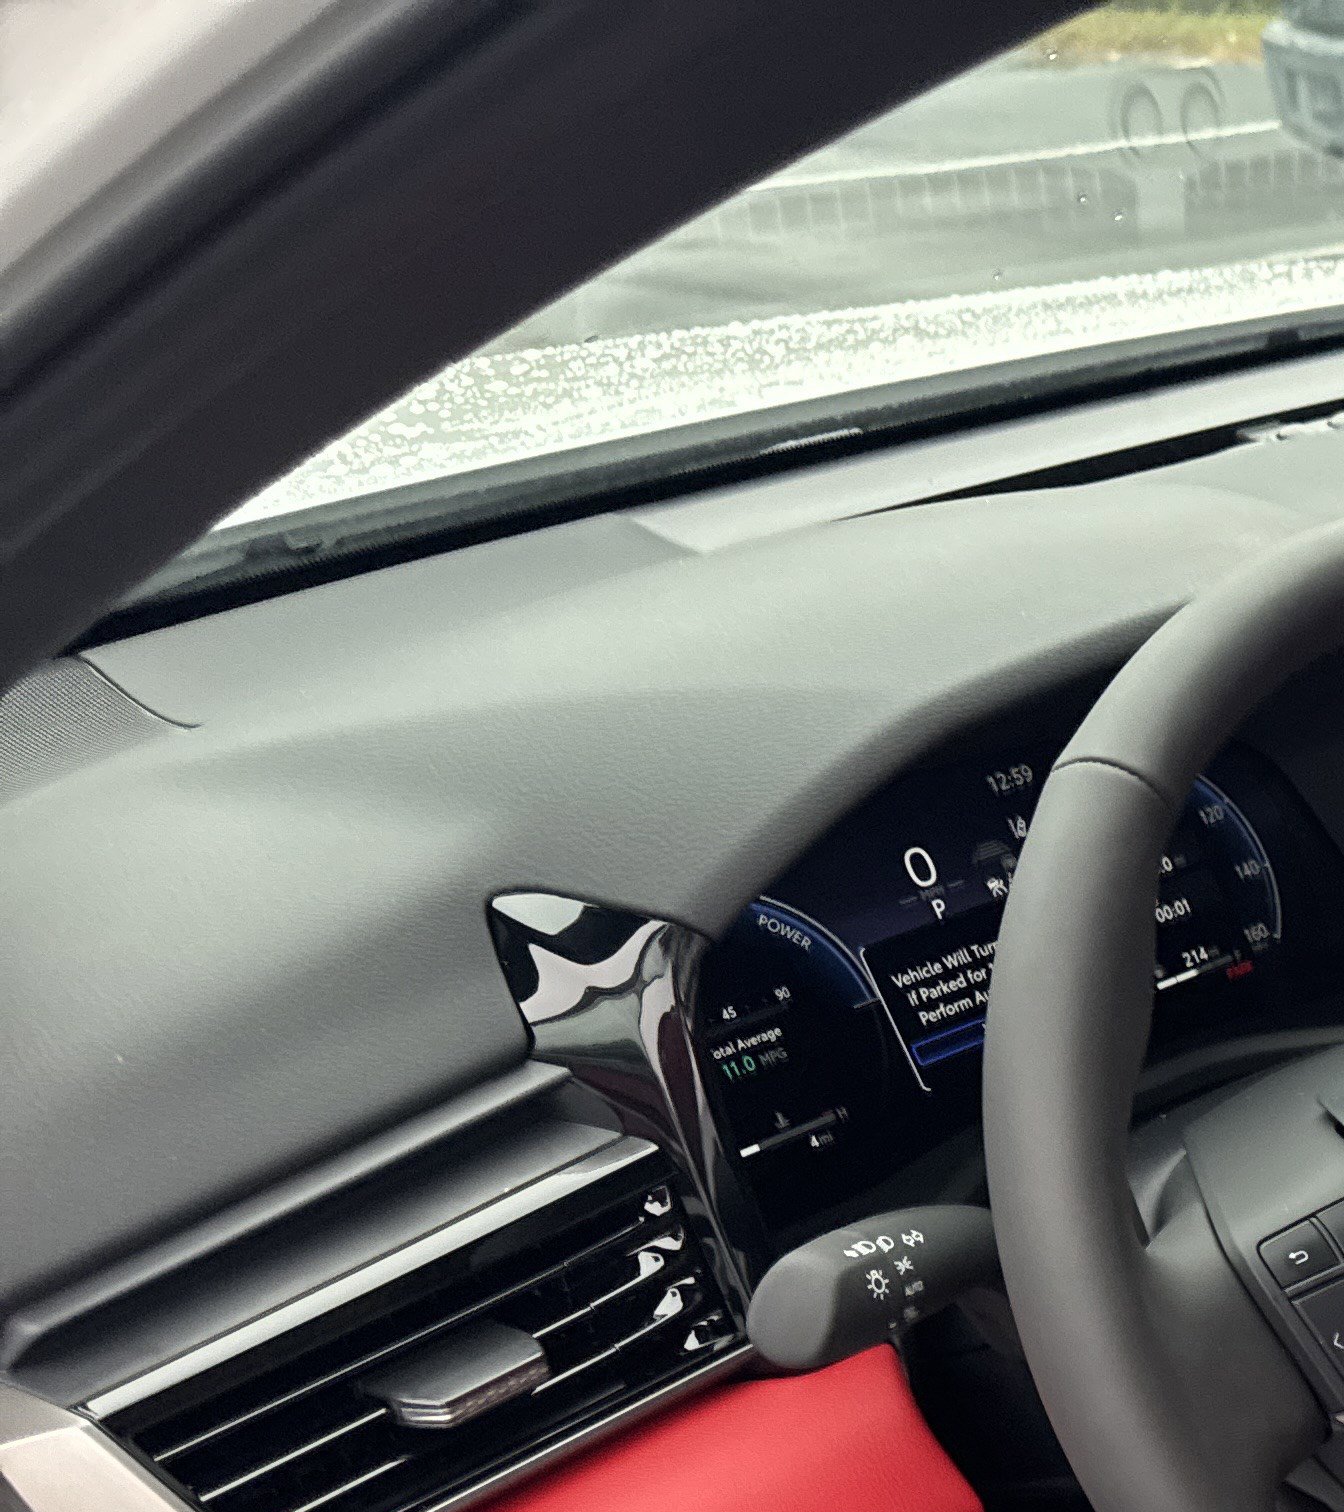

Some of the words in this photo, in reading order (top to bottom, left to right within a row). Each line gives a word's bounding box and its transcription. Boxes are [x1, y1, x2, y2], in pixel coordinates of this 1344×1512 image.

[986, 763, 1033, 794] 12:59
[1199, 804, 1225, 825] 120
[904, 847, 937, 888] 0
[1234, 859, 1261, 881] 140
[931, 899, 946, 920] P
[758, 913, 812, 951] POWER
[891, 960, 944, 988] Vehicle
[942, 946, 972, 970] Will
[1181, 945, 1209, 968] 214
[774, 985, 791, 1001] 90
[907, 990, 919, 1007] If
[920, 973, 968, 1003] Parked
[967, 968, 987, 985] for
[722, 1005, 737, 1020] 45
[918, 998, 974, 1026] Perform
[712, 1041, 736, 1061] otal
[736, 1027, 783, 1051] Average
[722, 1054, 756, 1082] 11.0
